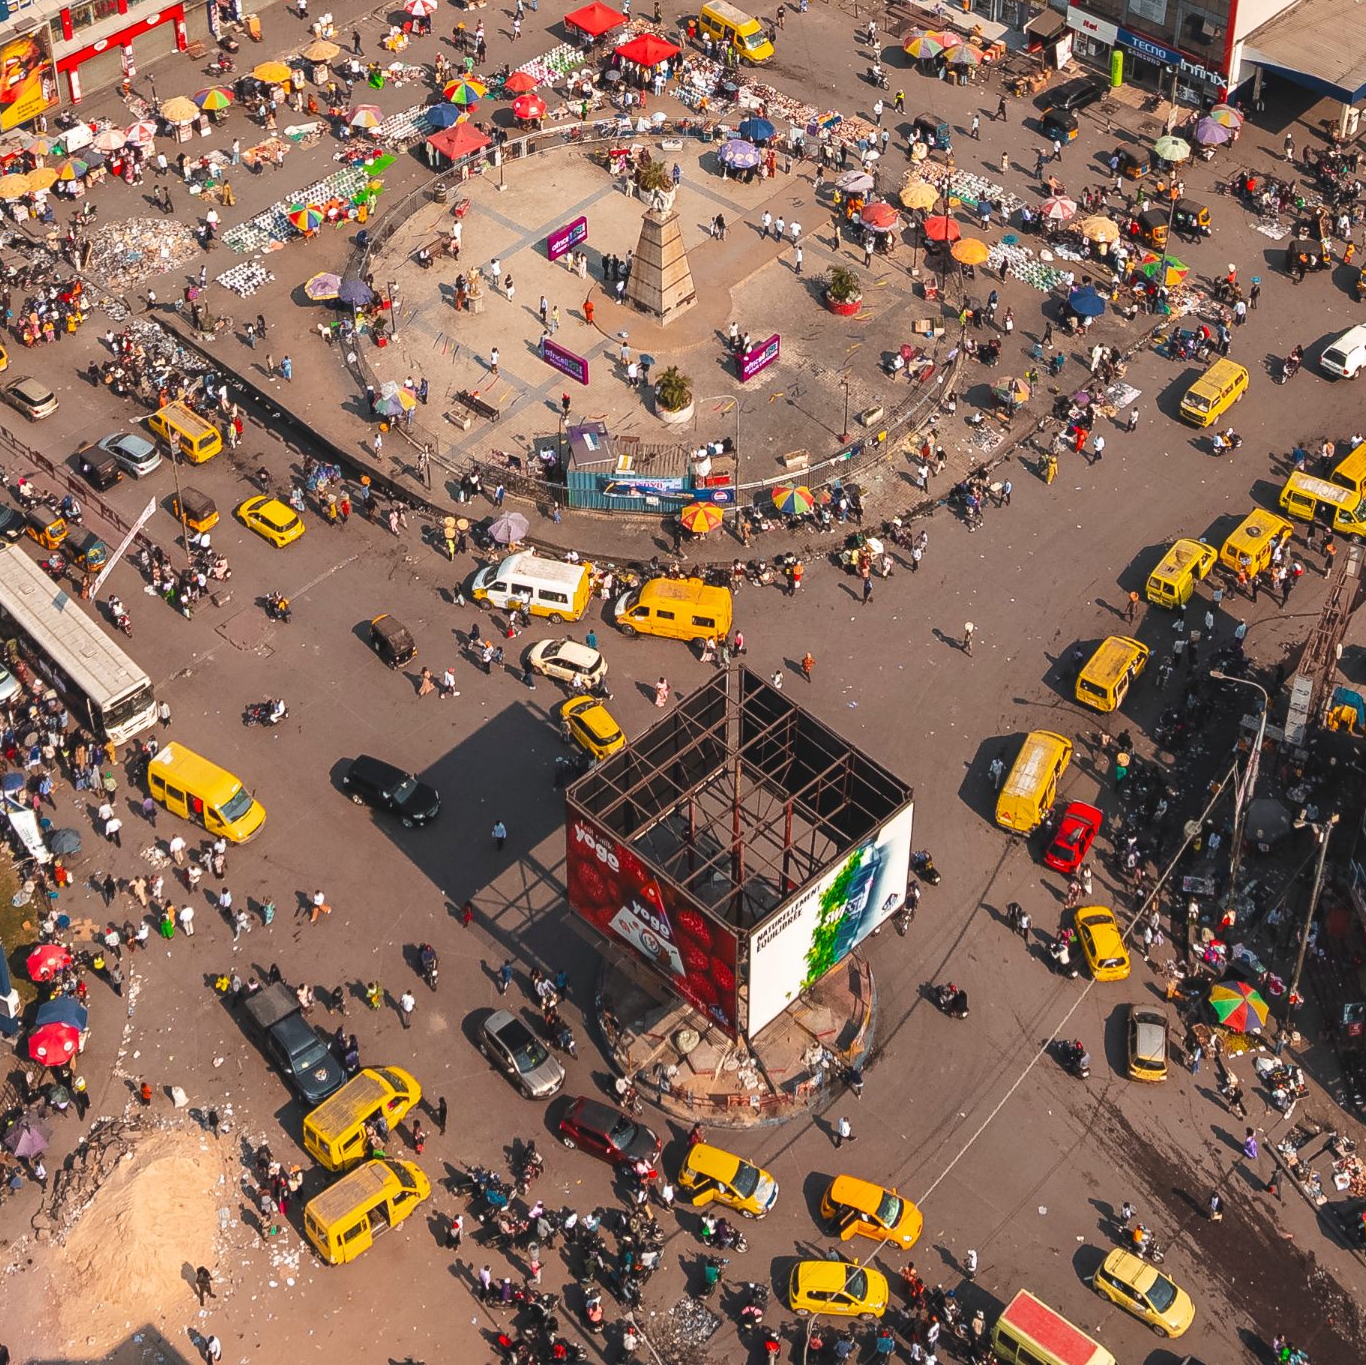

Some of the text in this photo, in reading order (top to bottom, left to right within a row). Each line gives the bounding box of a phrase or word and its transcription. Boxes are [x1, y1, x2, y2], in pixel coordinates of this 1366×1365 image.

[1127, 48, 1161, 66] SAMSUNG
[1131, 36, 1167, 59] TECNO
[574, 823, 620, 873] yogo
[632, 900, 670, 940] yogo
[757, 884, 821, 943] NATURELLEMENT
